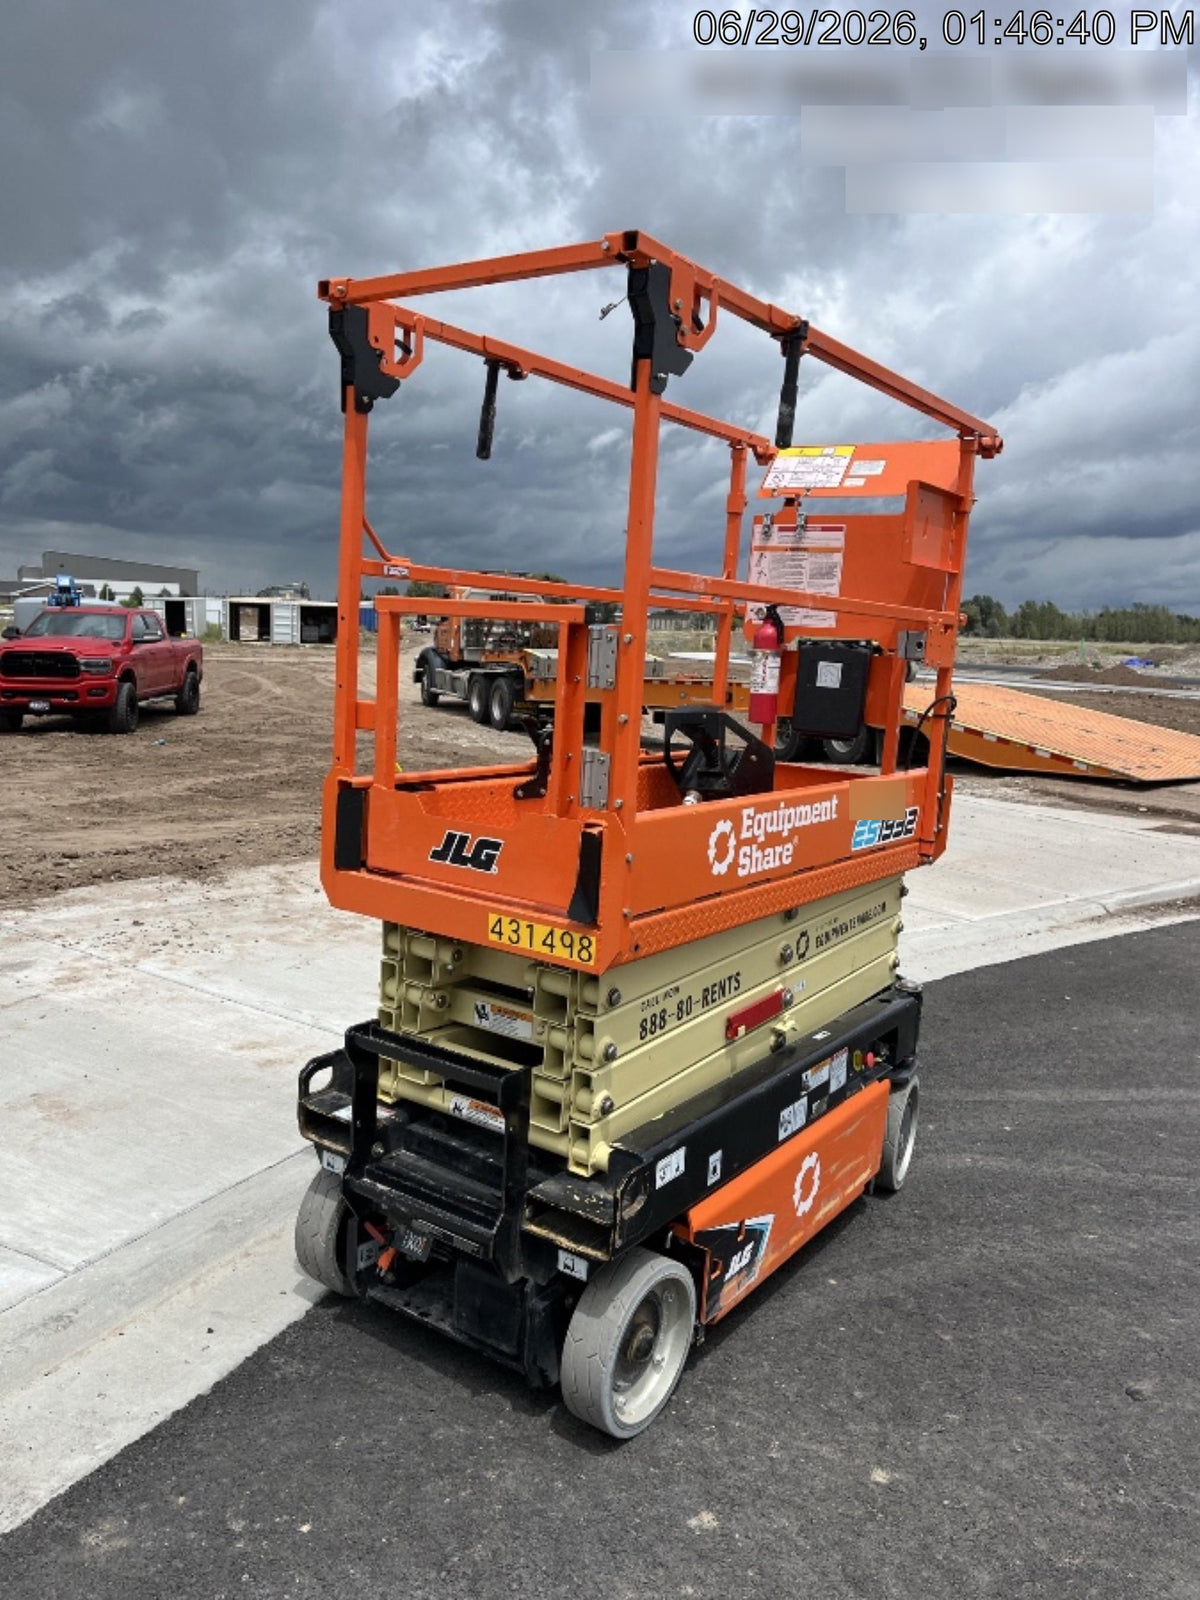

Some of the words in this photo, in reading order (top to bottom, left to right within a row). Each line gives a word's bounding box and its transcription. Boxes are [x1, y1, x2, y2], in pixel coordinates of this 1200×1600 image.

[740, 794, 838, 843] Equipment
[428, 830, 504, 874] JLG
[737, 841, 794, 877] Share
[490, 917, 593, 963] 431498
[639, 971, 741, 1041] 888-80-RENTS
[723, 1240, 755, 1282] JLG
